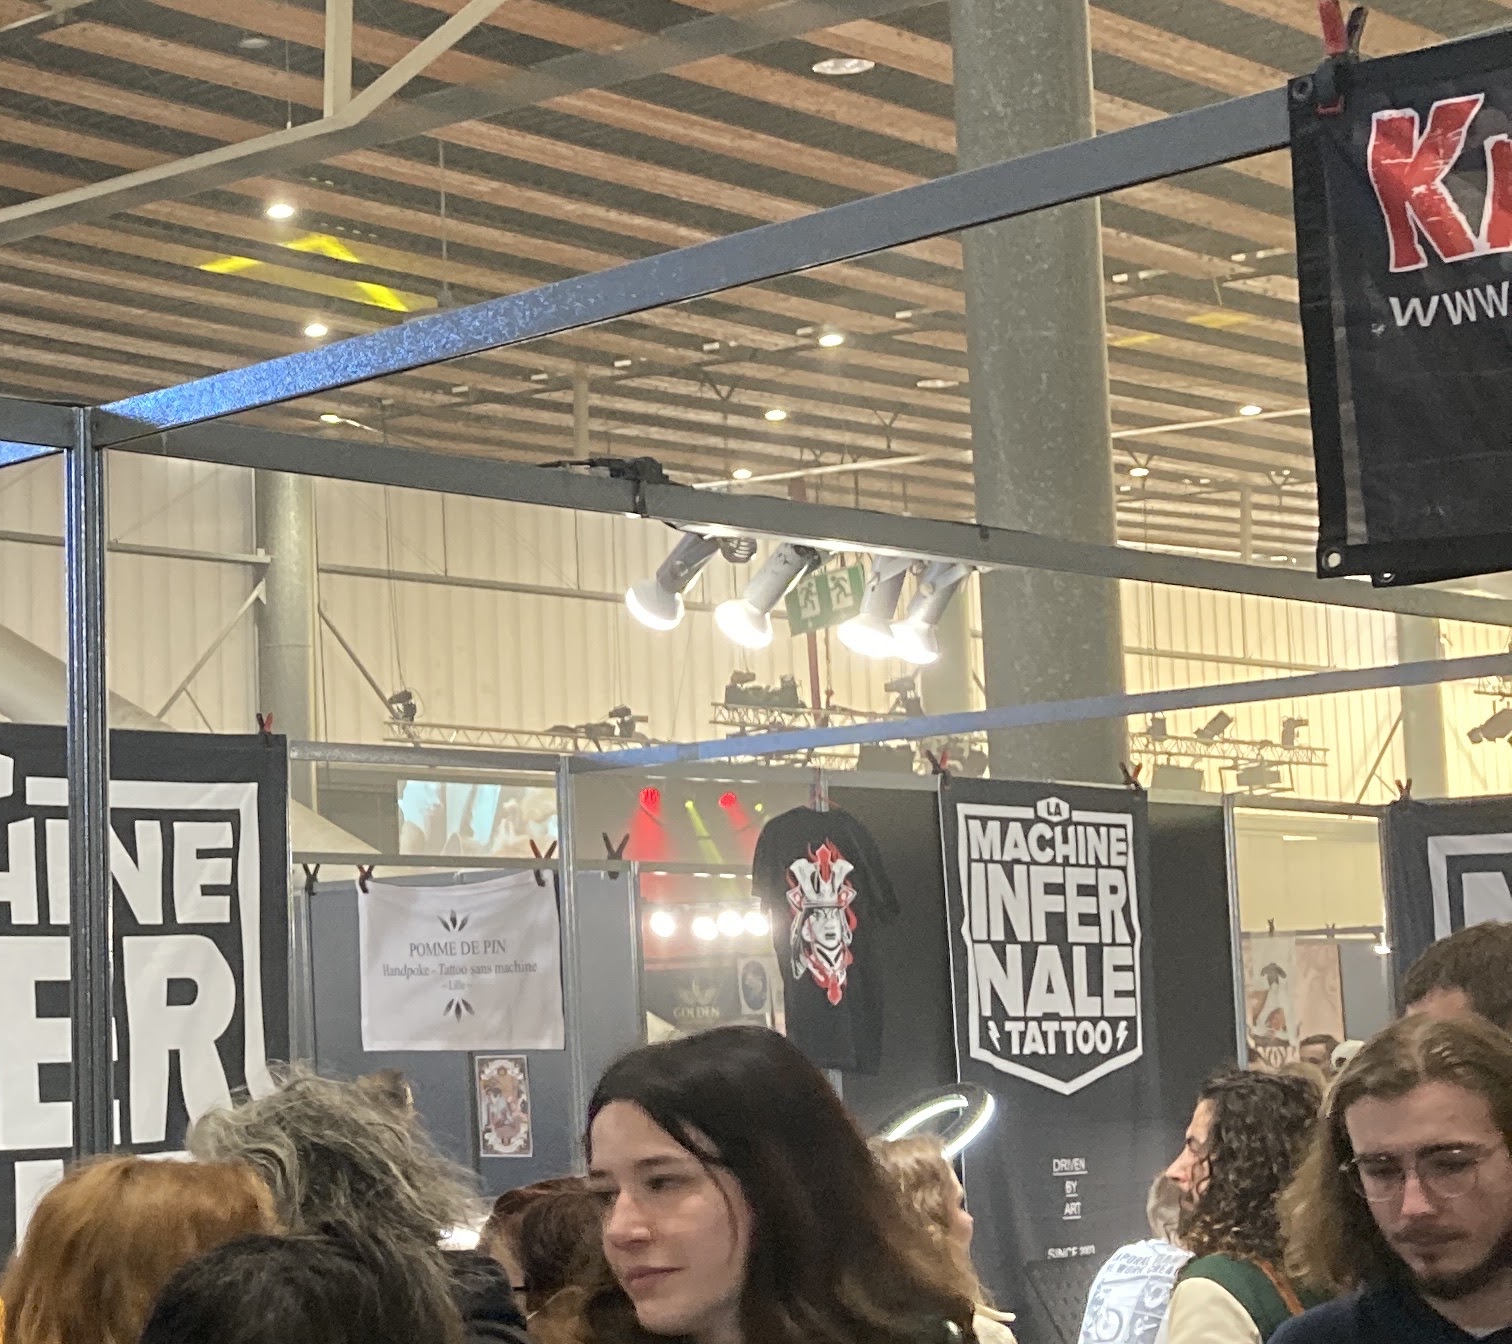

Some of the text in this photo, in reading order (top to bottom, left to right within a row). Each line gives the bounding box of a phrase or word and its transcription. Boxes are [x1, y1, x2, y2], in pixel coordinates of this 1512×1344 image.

[1046, 801, 1062, 817] LA
[967, 819, 1128, 866] MACHINE
[971, 862, 1131, 944] INFER
[409, 939, 506, 957] POMME DE PIN
[383, 963, 429, 979] Handpoke
[438, 963, 467, 976] Tattoo
[494, 960, 537, 974] machine
[972, 942, 1136, 1018] NALE
[1004, 1020, 1113, 1055] TATTOO
[1053, 1158, 1085, 1171] DRIVEN
[1065, 1181, 1078, 1193] BY
[1064, 1202, 1082, 1215] ART
